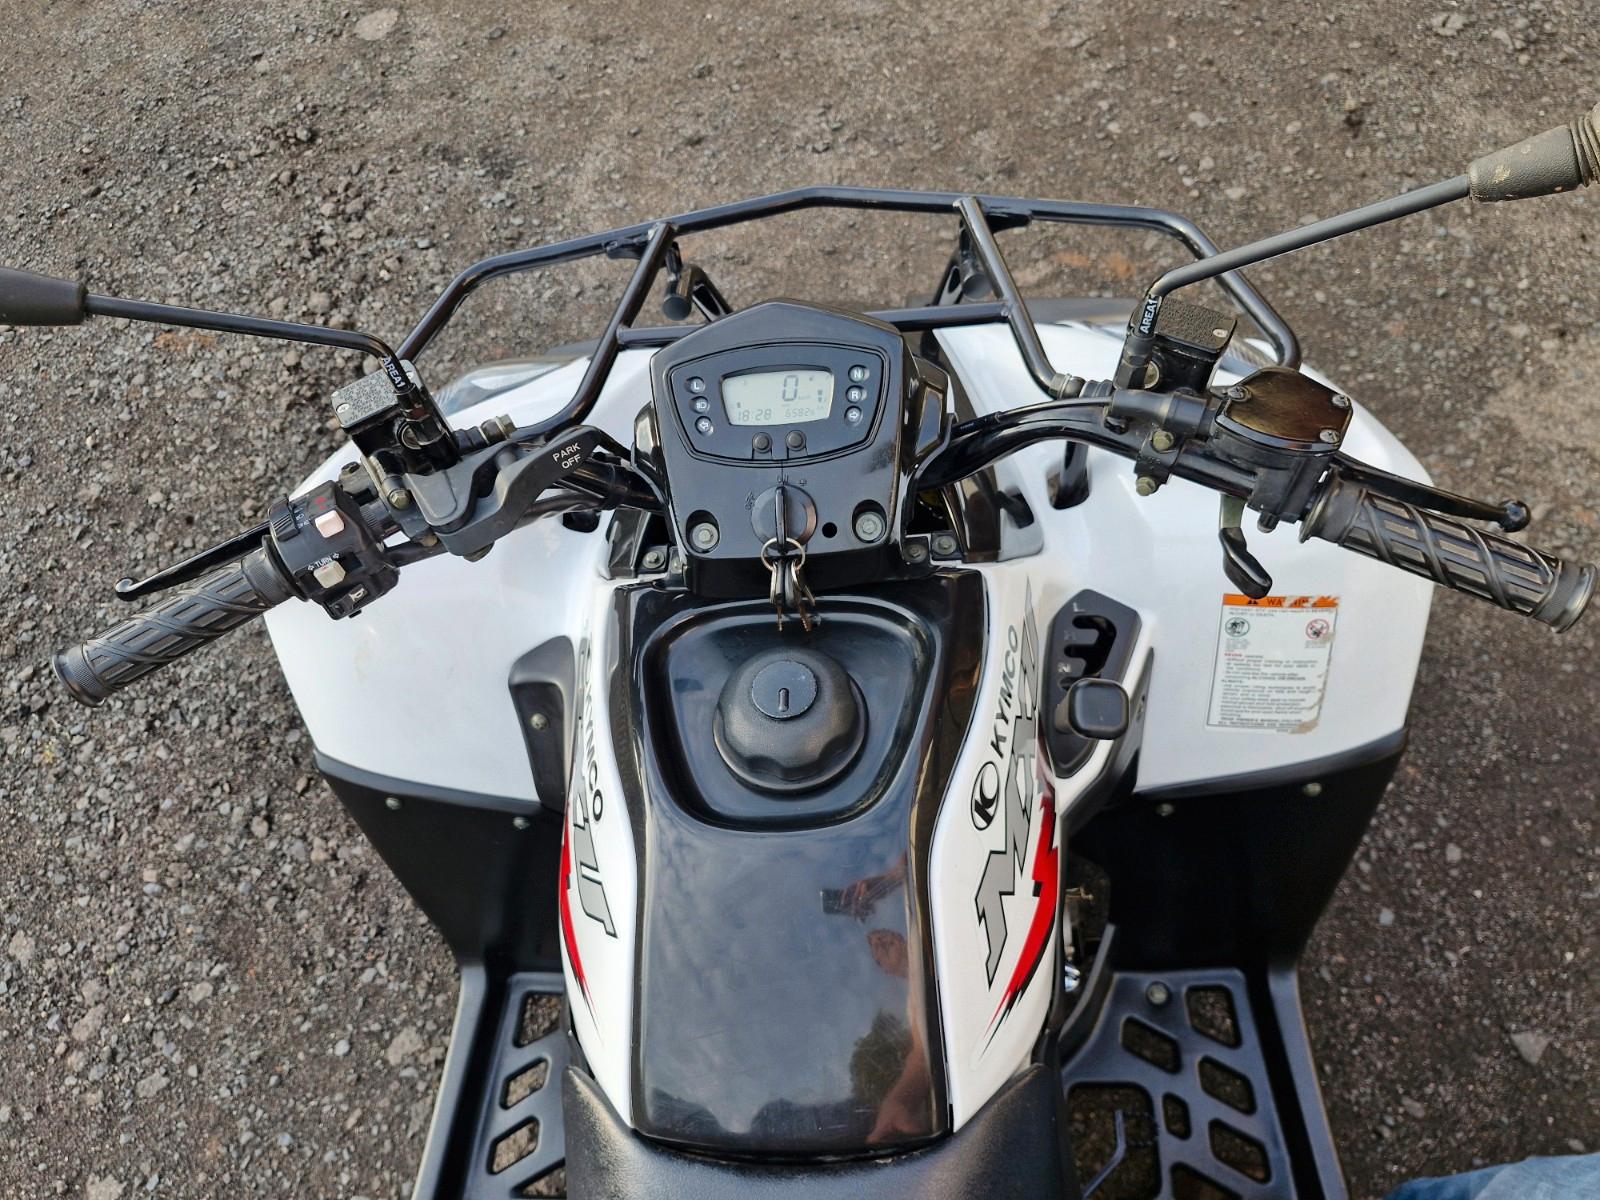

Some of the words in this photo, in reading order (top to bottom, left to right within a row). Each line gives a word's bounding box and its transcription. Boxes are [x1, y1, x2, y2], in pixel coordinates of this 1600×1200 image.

[1140, 298, 1158, 334] AREA1
[383, 356, 406, 388] AREA1
[782, 375, 799, 402] 0
[851, 391, 859, 399] R
[738, 408, 772, 422] 18:28
[552, 442, 581, 462] PARK
[561, 454, 581, 469] OFF
[315, 555, 333, 568] TURN
[990, 624, 1018, 760] KYMCO
